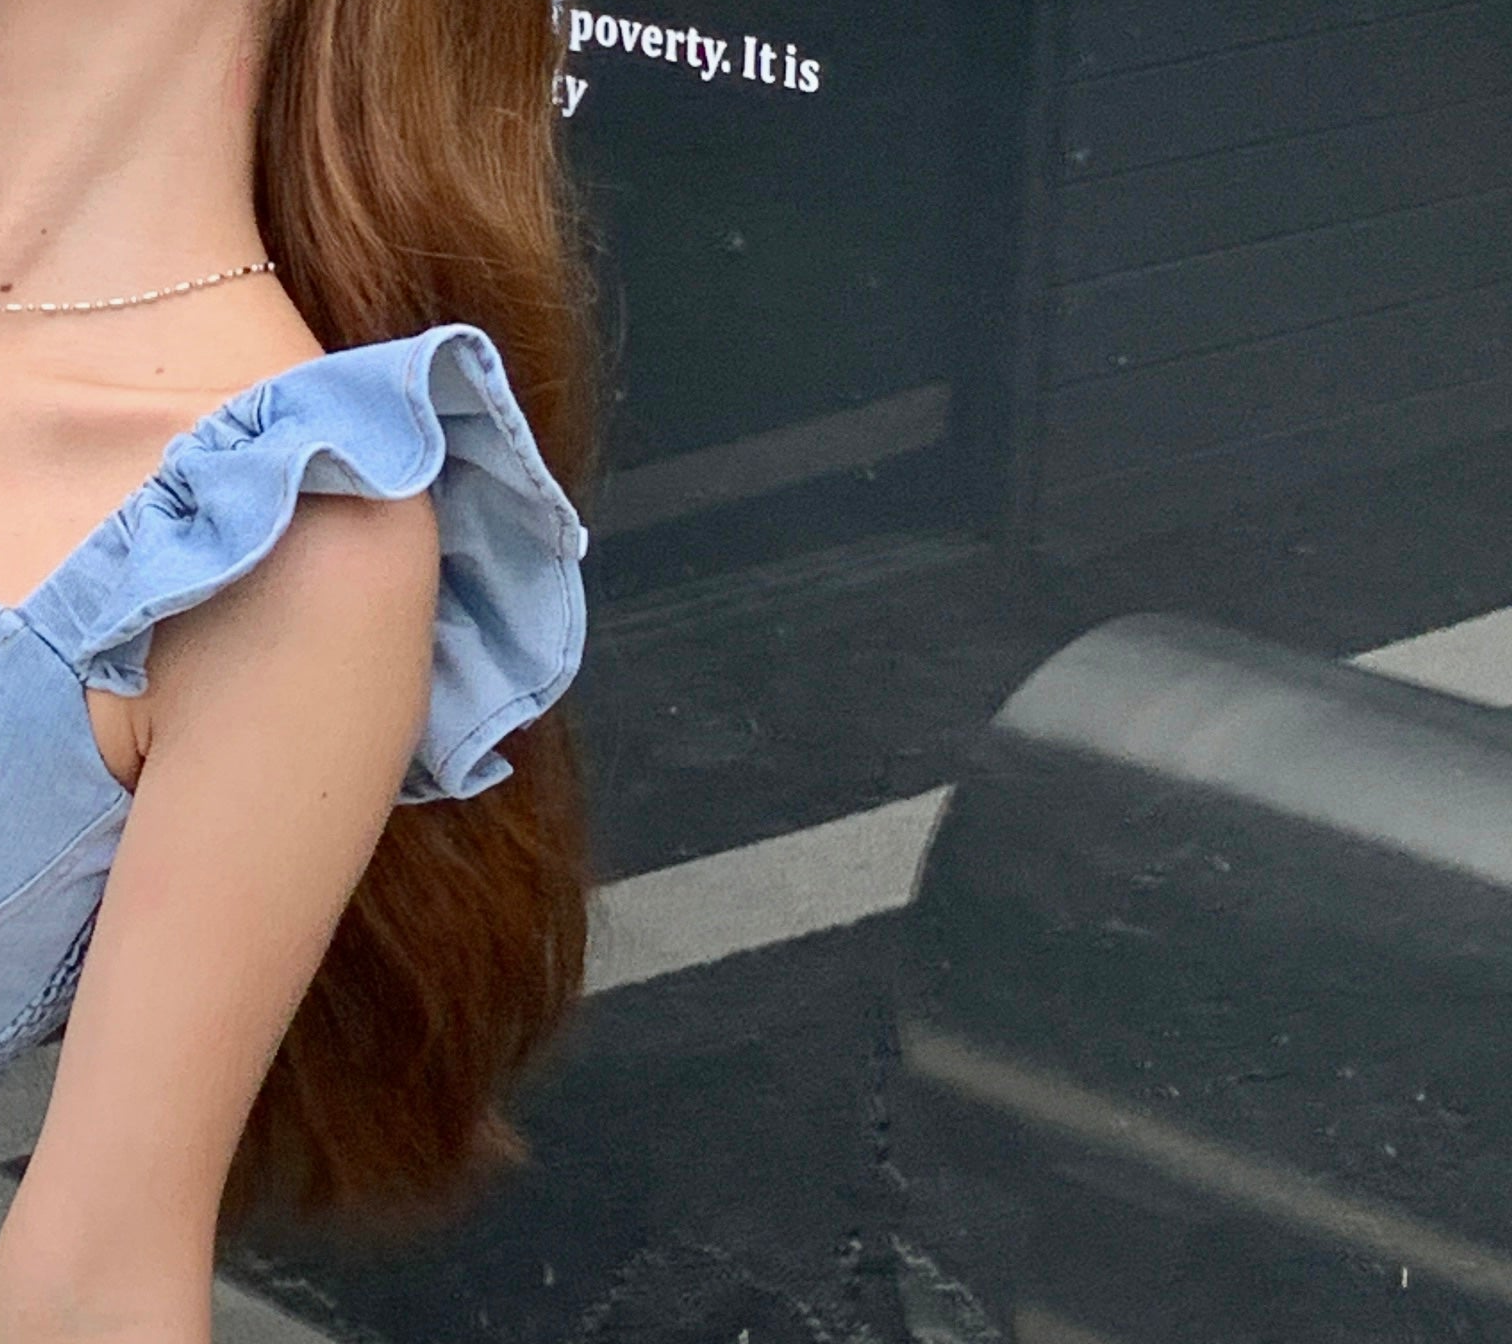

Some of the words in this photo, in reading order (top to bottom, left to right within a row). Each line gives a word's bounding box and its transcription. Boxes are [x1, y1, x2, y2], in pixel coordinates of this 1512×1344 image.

[569, 9, 731, 81] poverty.
[743, 36, 777, 84] It
[784, 44, 821, 93] is
